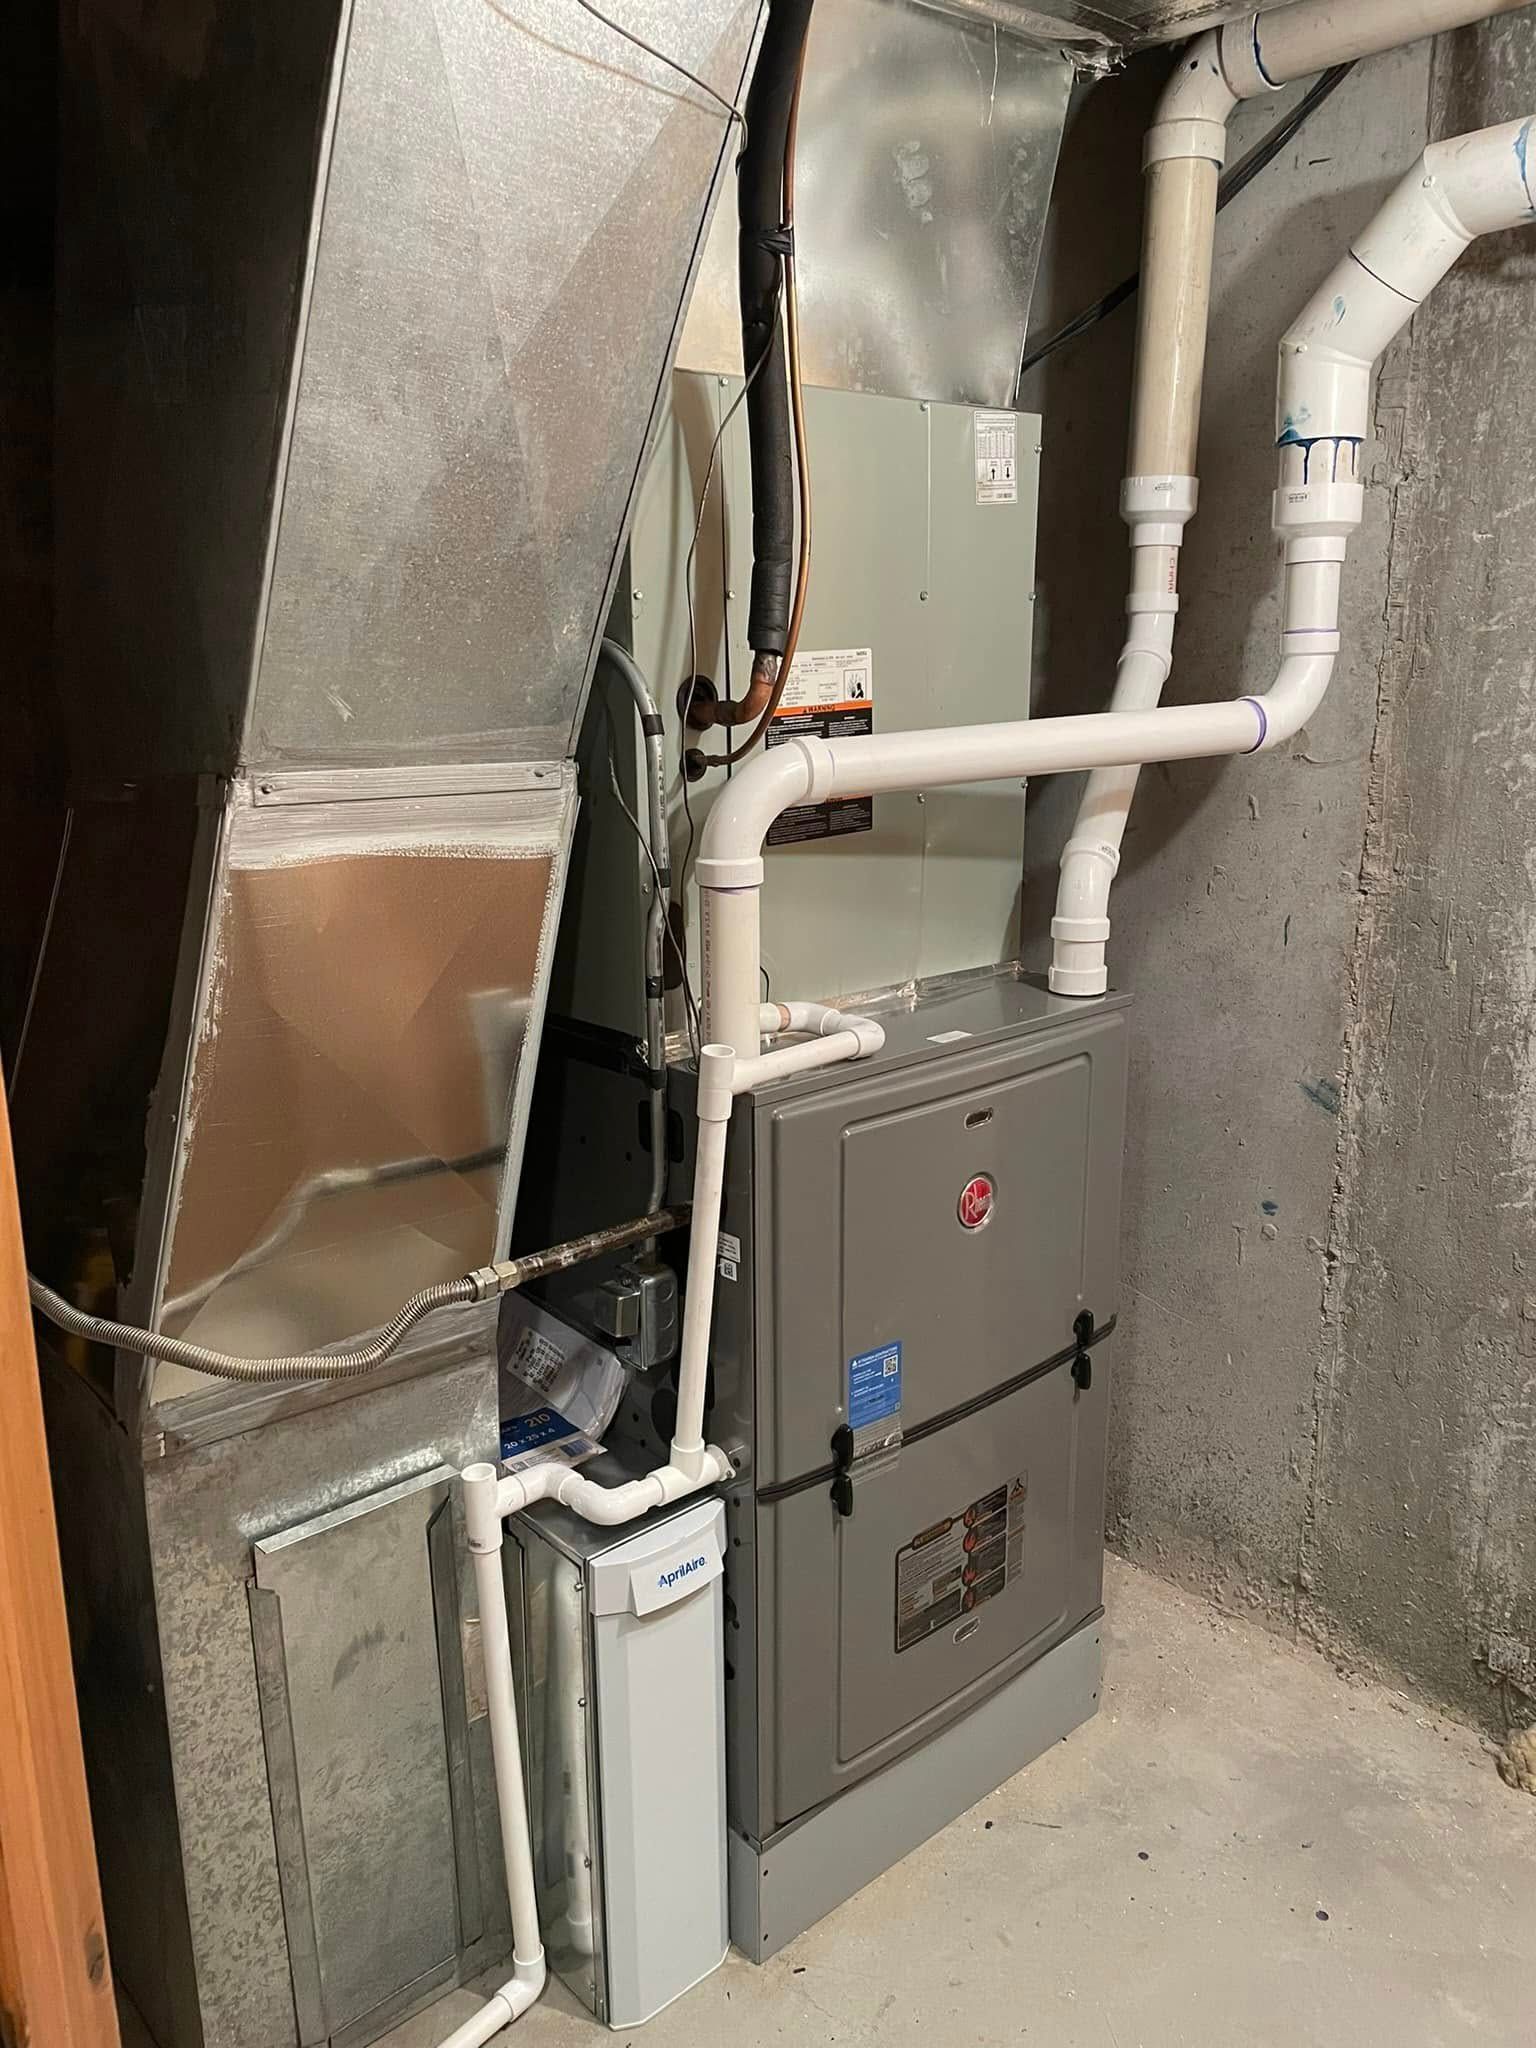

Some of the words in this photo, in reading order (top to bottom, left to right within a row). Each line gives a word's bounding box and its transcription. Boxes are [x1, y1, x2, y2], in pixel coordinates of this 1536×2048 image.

[524, 1414, 550, 1427] 210
[504, 1441, 518, 1449] 20
[657, 1556, 705, 1587] AprilAire
